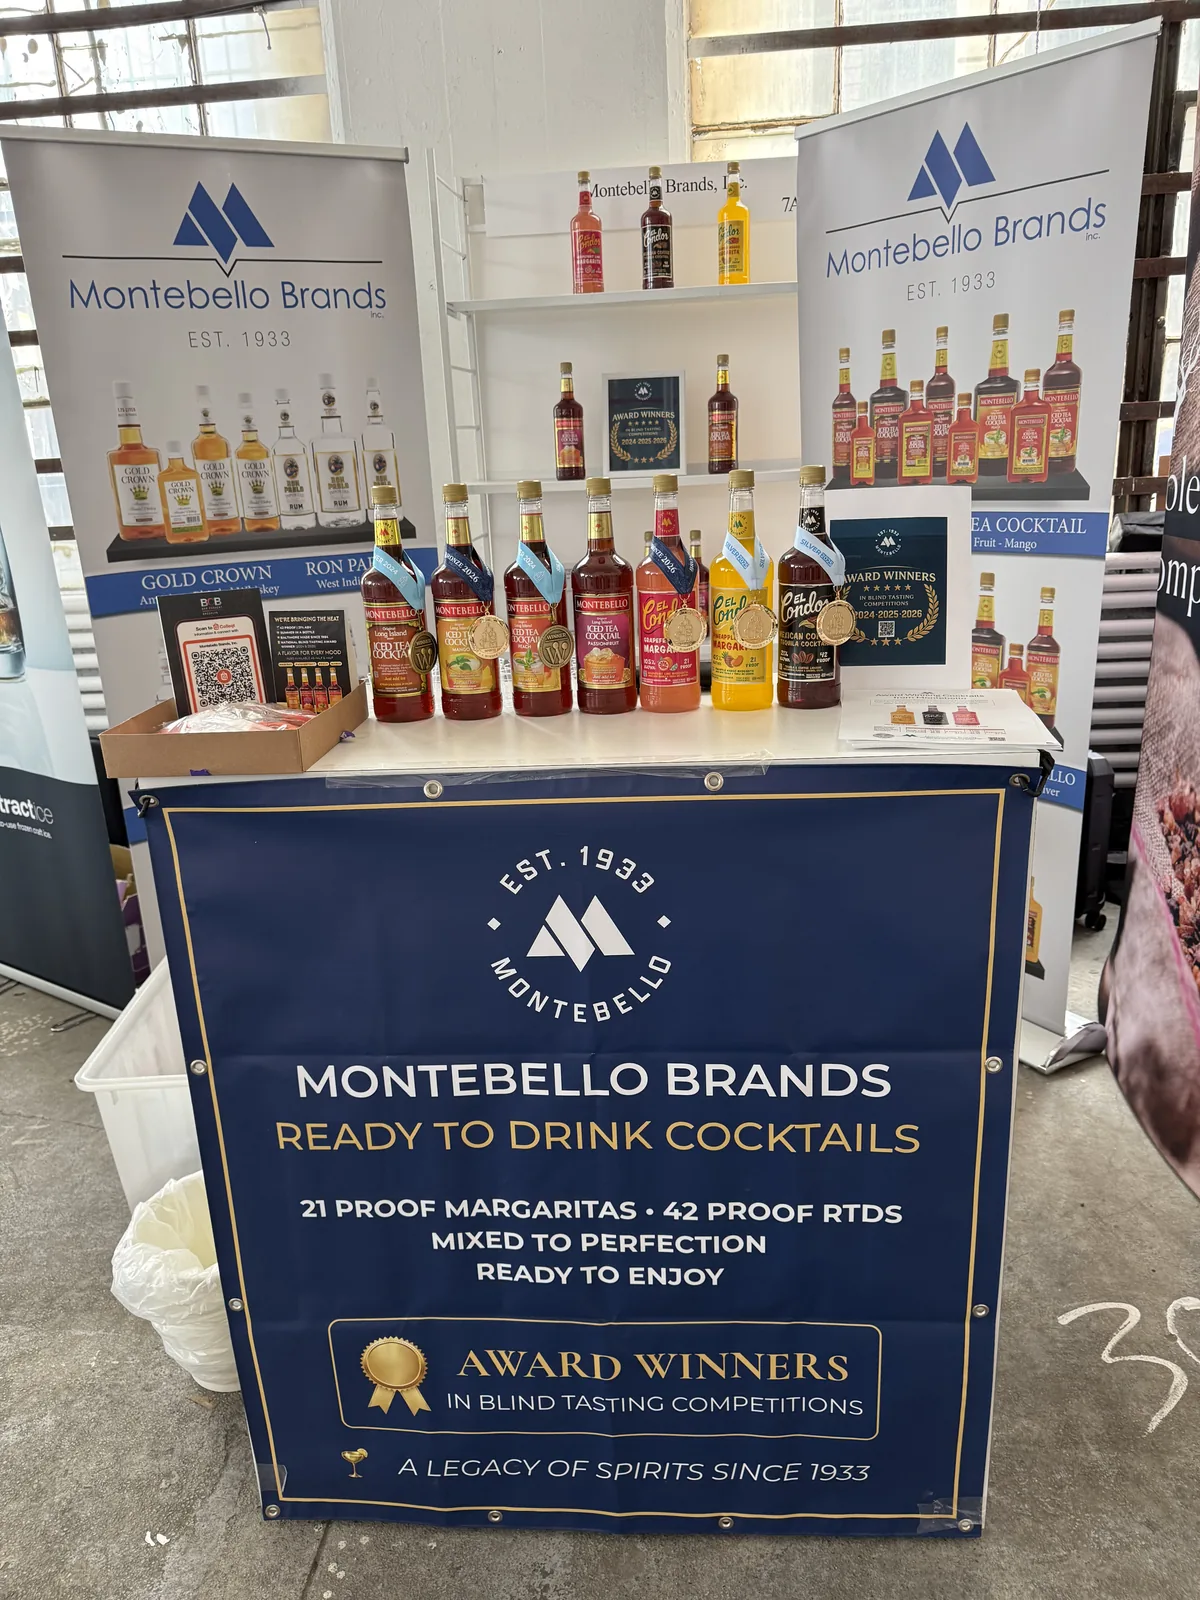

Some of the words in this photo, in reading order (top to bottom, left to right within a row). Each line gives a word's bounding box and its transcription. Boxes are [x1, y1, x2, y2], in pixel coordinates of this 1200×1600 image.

[590, 180, 651, 198] Montebell
[666, 177, 717, 193] Brands,
[722, 175, 748, 190] Ic.
[826, 223, 982, 278] Montebello
[994, 197, 1107, 247] Brands
[69, 278, 270, 310] Montebello
[281, 280, 387, 310] Brands
[907, 281, 941, 301] EST.
[951, 271, 996, 294] 1933
[188, 330, 231, 349] EST.
[242, 330, 292, 349] 1933
[612, 411, 640, 421] AWARD
[641, 410, 675, 420] WINNERS
[124, 466, 150, 475] GOLD
[204, 463, 225, 471] GOLD
[244, 462, 265, 470] GOLD
[121, 475, 155, 484] CROWN
[200, 470, 230, 480] CROWN
[241, 470, 270, 479] CROWN
[971, 517, 992, 532] EA
[996, 517, 1087, 534] COCKTAIL
[725, 541, 740, 558] SILVER
[800, 538, 822, 556] SILVER
[974, 537, 996, 547] Fruit
[1004, 537, 1037, 552] Mango
[383, 561, 399, 575] 2024
[660, 556, 677, 574] 2026
[141, 571, 197, 590] GOLD
[201, 565, 272, 585] CROWN
[305, 560, 343, 576] RON
[462, 565, 479, 583] 2026
[883, 571, 937, 583] WINNERS
[316, 580, 340, 588] West
[577, 599, 628, 609] MONTEBELLO
[656, 600, 668, 611] EL
[724, 597, 736, 607] EL
[794, 593, 806, 605] EL
[365, 608, 418, 619] MONTEBELLO
[508, 603, 551, 612] ONTEBELLO
[585, 632, 621, 640] COCKTAIL
[373, 642, 393, 651] ICED
[393, 641, 410, 650] TEA
[972, 646, 999, 655] ONTEBELLO
[373, 650, 409, 660] COCKTA
[1048, 769, 1076, 785] LLO
[0, 795, 54, 825] tractice
[499, 848, 567, 895] EST.
[579, 845, 655, 894] 1933
[490, 954, 672, 1023] MONTEBELLO
[296, 1062, 649, 1098] MONTEBELLO
[666, 1062, 892, 1098] BRANDS
[275, 1121, 423, 1151] READY
[433, 1120, 494, 1150] TO
[508, 1120, 653, 1150] DRINK
[665, 1121, 921, 1154] COCKTAILS
[299, 1199, 327, 1218] 21
[335, 1199, 436, 1218] PROOF
[444, 1198, 637, 1220] MARGARITAS
[662, 1201, 699, 1221] 42
[707, 1201, 814, 1223] PROOF
[823, 1203, 903, 1224] RTDS
[431, 1230, 524, 1251] MIXED
[531, 1233, 572, 1252] TO
[580, 1233, 767, 1254] PERFECTION
[476, 1262, 573, 1285] READY
[580, 1265, 620, 1284] TO
[628, 1267, 725, 1286] ENJOY
[456, 1349, 622, 1381] AWARD
[633, 1352, 849, 1382] WINNERS
[447, 1393, 471, 1410] IN
[479, 1394, 555, 1412] BLIND
[561, 1395, 664, 1413] TASTING
[671, 1396, 864, 1416] COMPETITIONS
[397, 1458, 418, 1476] A
[427, 1459, 541, 1477] LEGACY
[547, 1459, 590, 1478] OF
[595, 1461, 705, 1481] SPIRITS
[711, 1462, 802, 1482] SINCE
[810, 1463, 871, 1482] 1933
